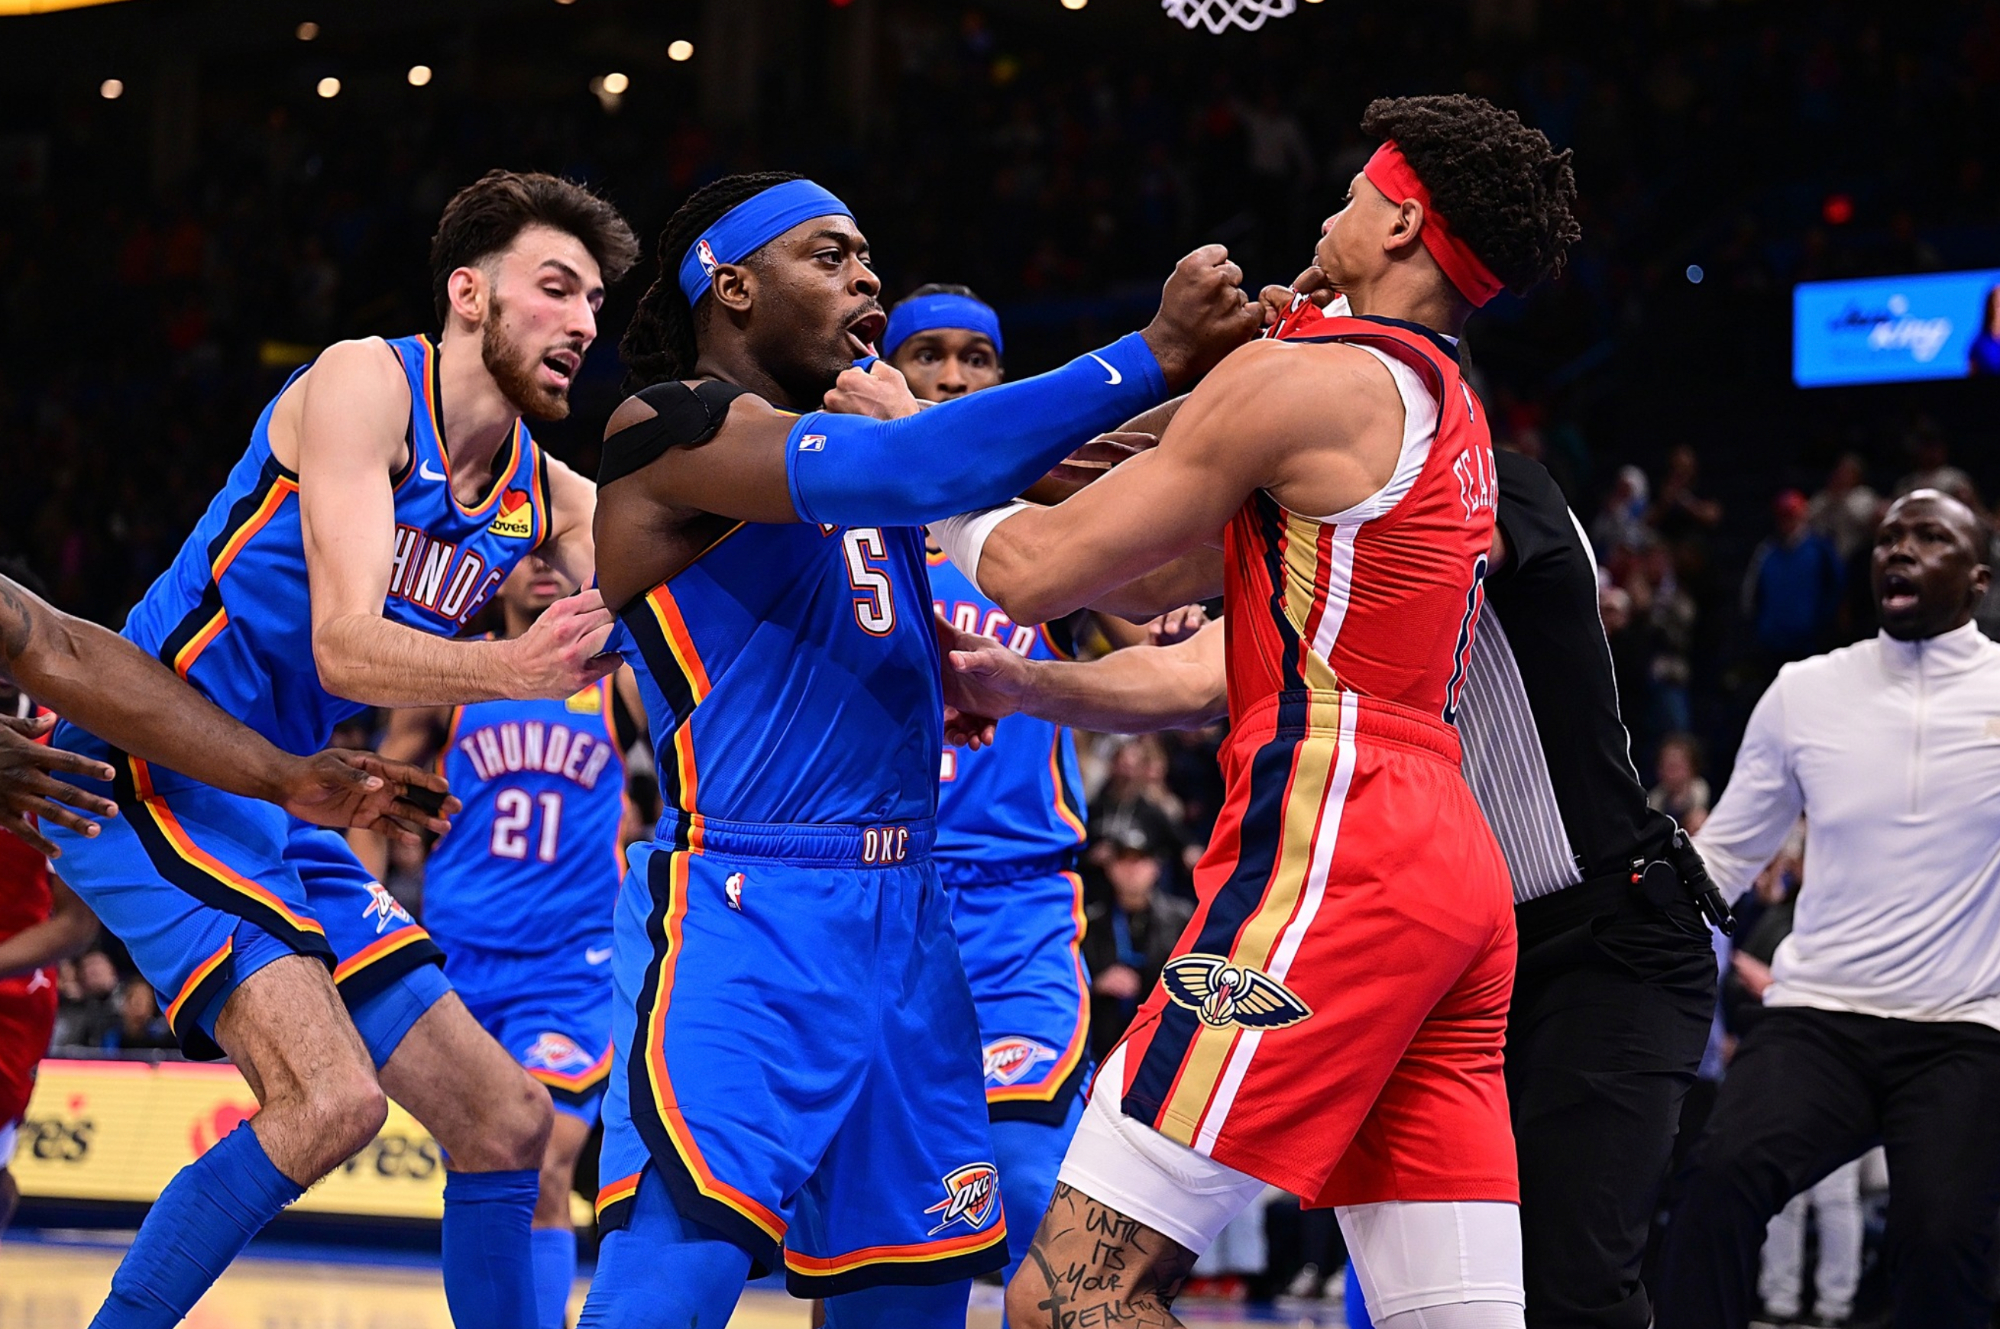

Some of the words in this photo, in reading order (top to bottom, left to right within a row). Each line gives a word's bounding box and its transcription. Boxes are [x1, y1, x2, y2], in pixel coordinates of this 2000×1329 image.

[1453, 444, 1499, 522] FEAR
[490, 520, 529, 534] oves
[388, 525, 504, 629] HUNDE
[842, 526, 897, 638] 5
[459, 720, 612, 790] THUNDER
[489, 786, 563, 864] 21
[863, 827, 909, 865] OKC
[946, 1173, 990, 1220] OKC
[1086, 1206, 1148, 1255] UNTIL
[1092, 1239, 1126, 1270] ITS
[1066, 1261, 1124, 1302] YOUR
